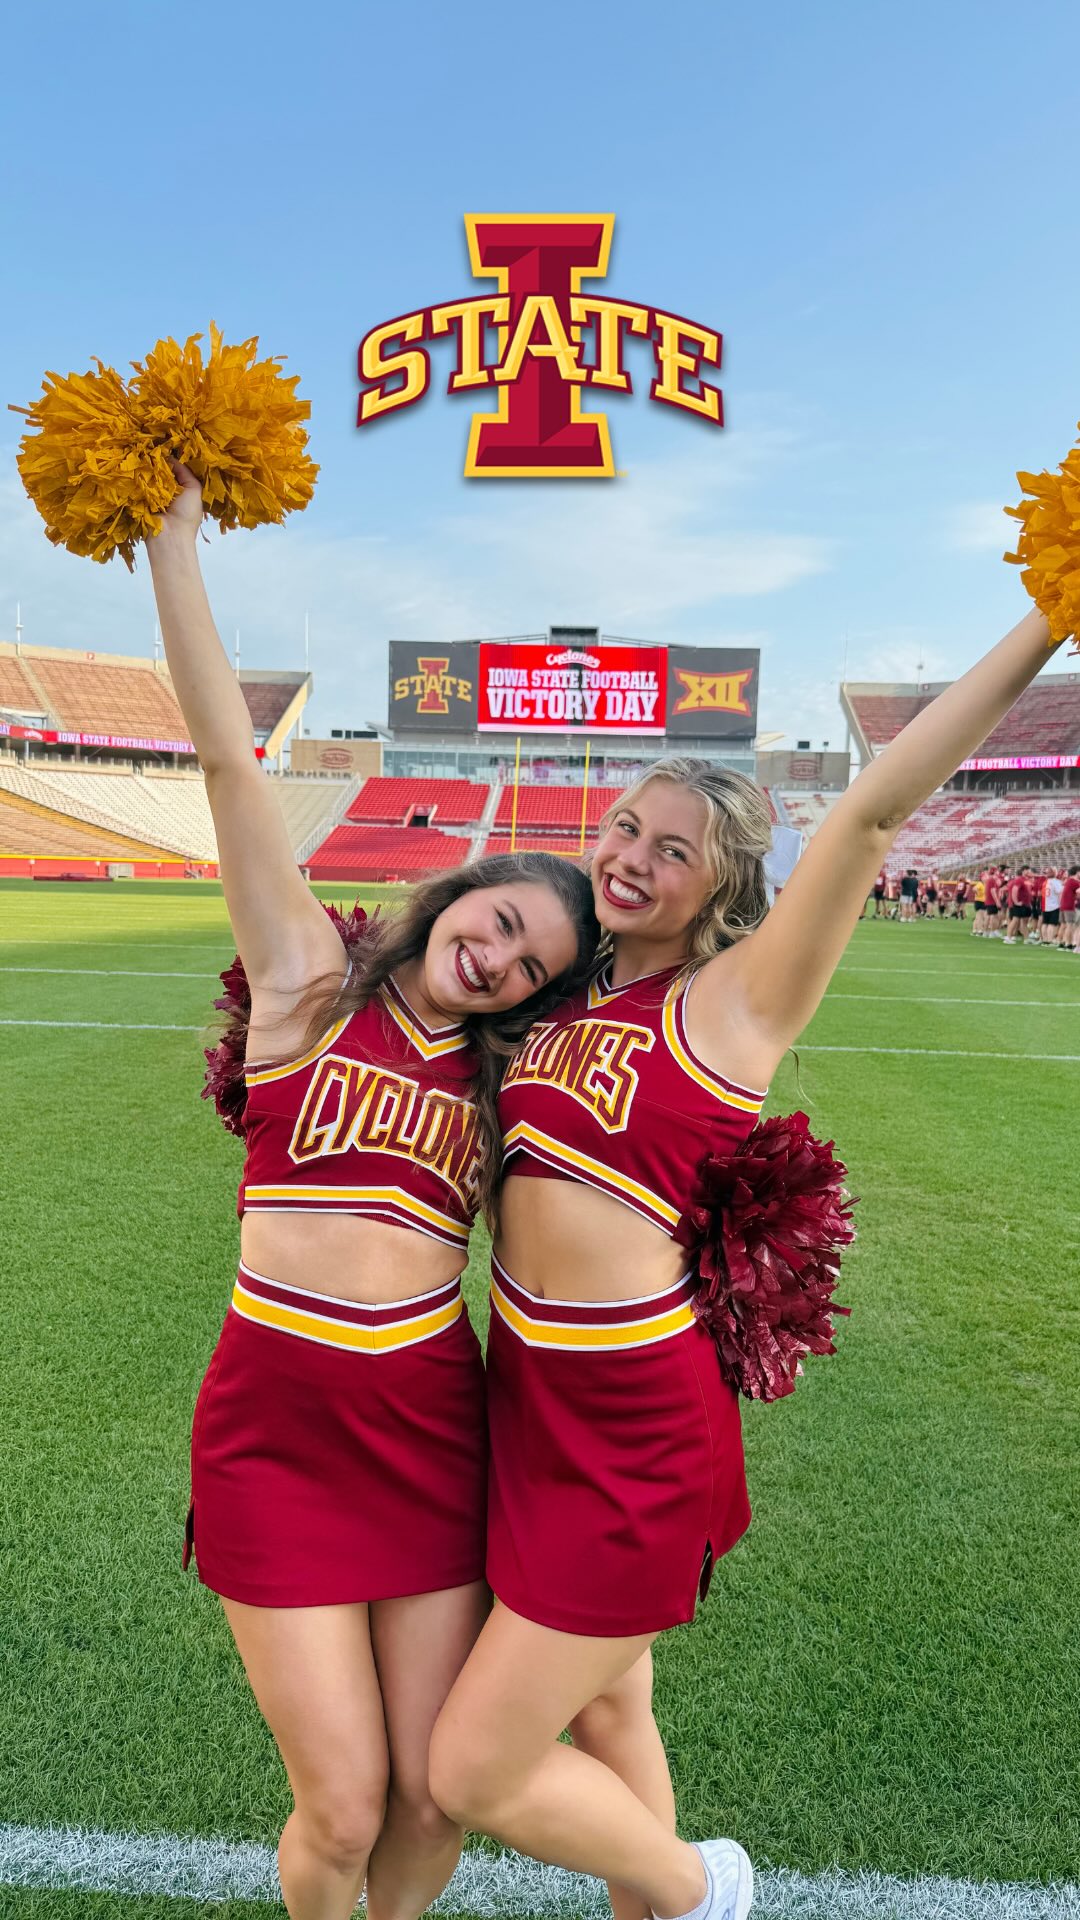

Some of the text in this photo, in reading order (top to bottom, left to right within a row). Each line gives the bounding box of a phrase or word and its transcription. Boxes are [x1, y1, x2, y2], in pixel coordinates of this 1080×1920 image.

[546, 649, 601, 669] Cyclones
[394, 674, 472, 702] STATE
[487, 667, 659, 690] IOWA STATE FOOTBALL
[673, 668, 753, 717] XII
[486, 687, 659, 721] VICTORY DAY
[57, 732, 81, 743] IOWA
[83, 735, 110, 746] STATE
[112, 736, 154, 750] FOOTBALL
[156, 740, 189, 752] VICTORY
[977, 758, 1019, 769] FOOTBALL
[1020, 757, 1057, 768] VICTORY
[1060, 756, 1077, 767] DAY
[501, 1018, 656, 1135] CLONES
[288, 1054, 484, 1213] CYCLONE
